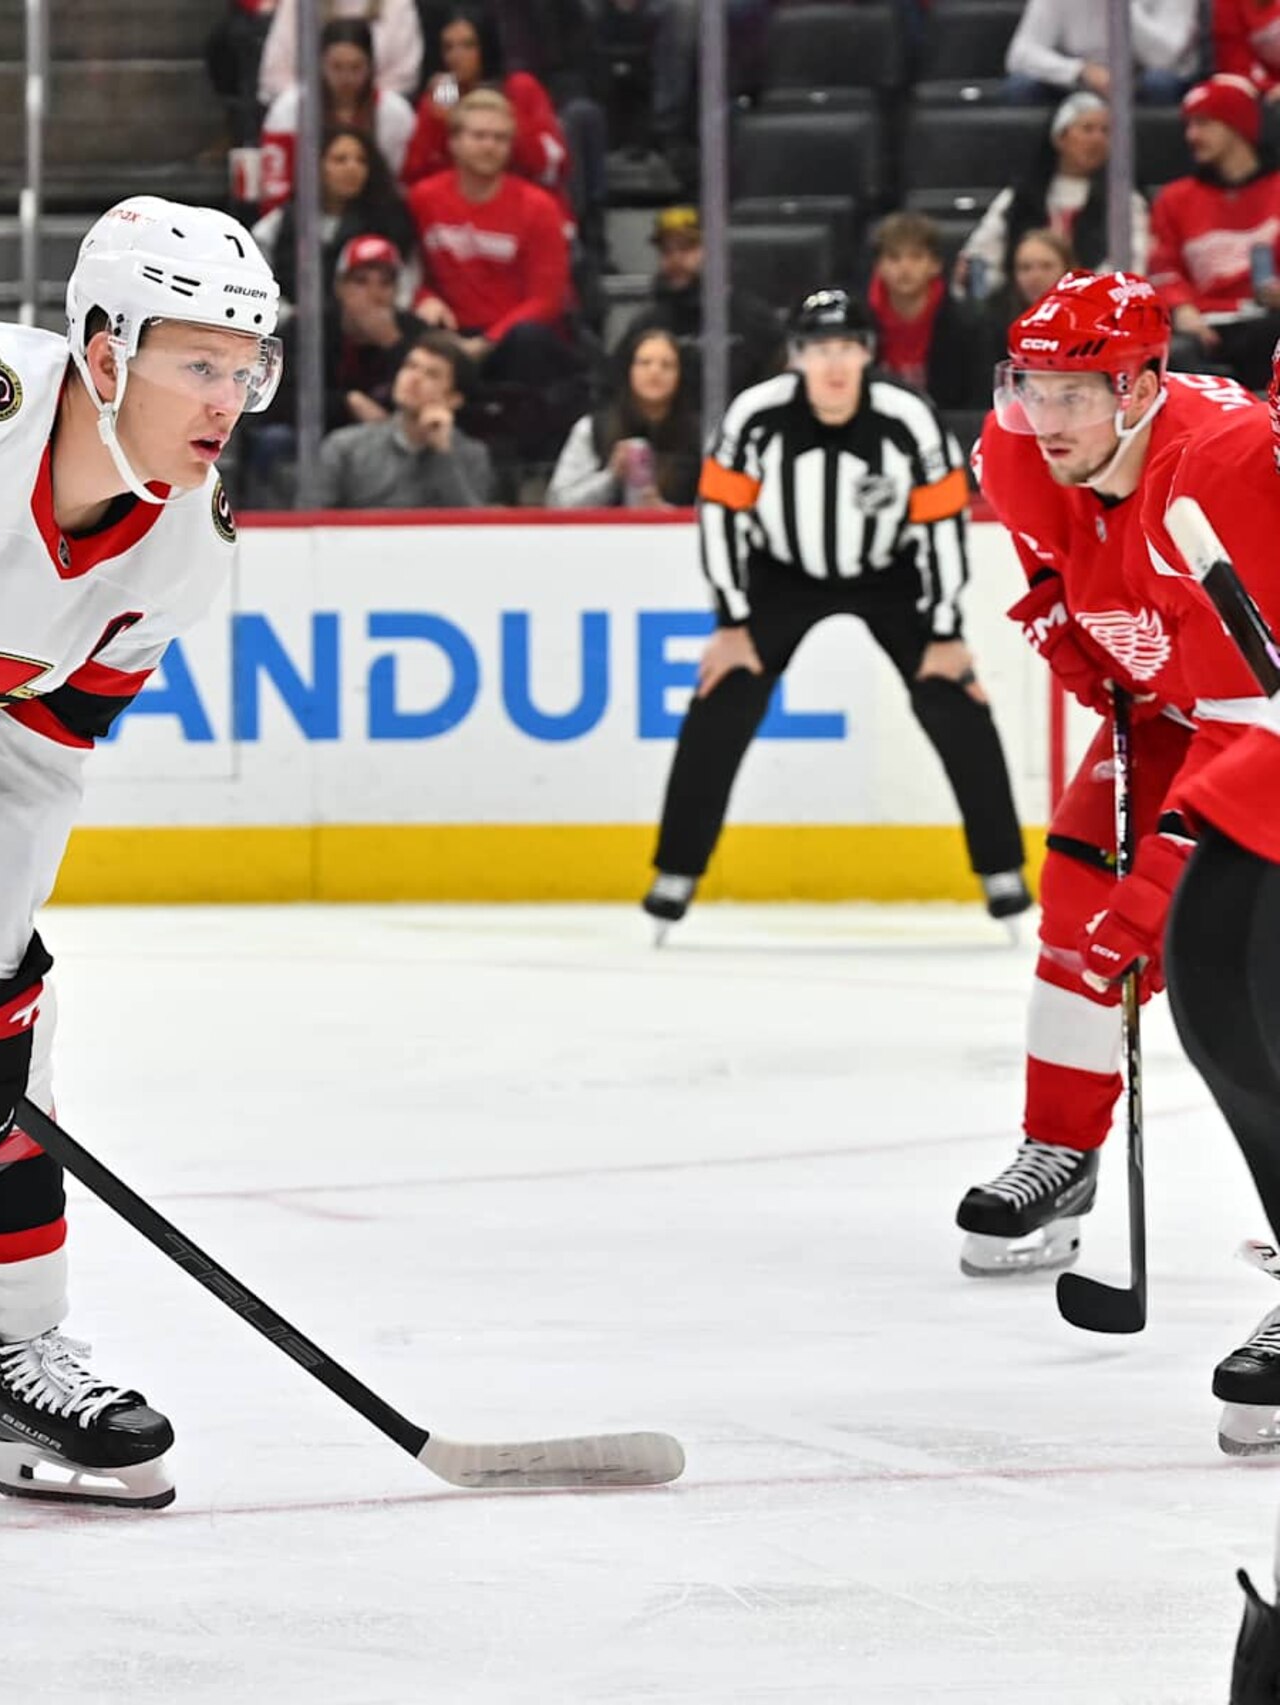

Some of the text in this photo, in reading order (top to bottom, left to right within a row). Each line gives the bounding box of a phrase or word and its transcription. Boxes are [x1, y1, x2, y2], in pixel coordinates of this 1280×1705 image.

[223, 233, 245, 258] 7
[1019, 337, 1059, 352] CCM
[104, 609, 847, 742] ANDUEL
